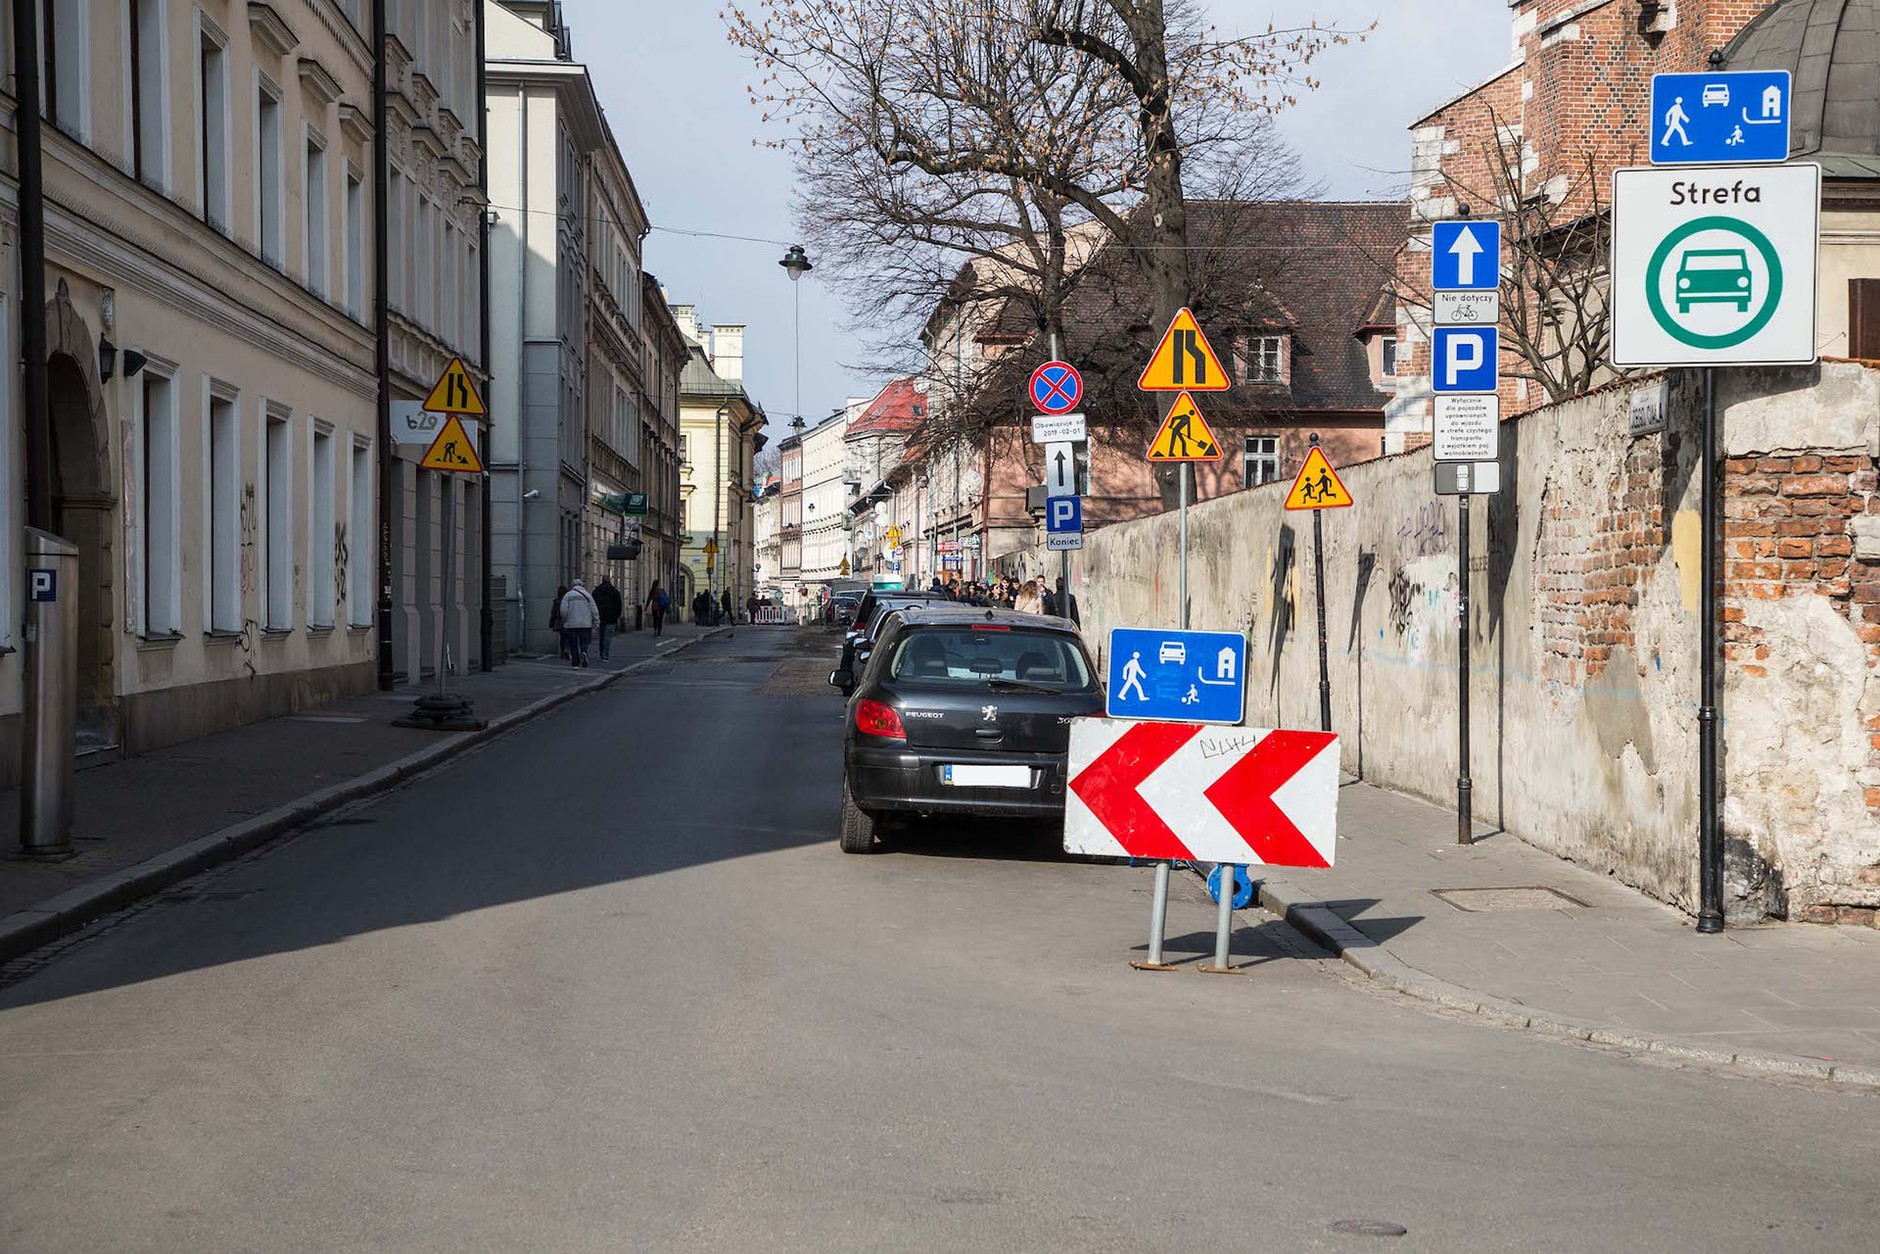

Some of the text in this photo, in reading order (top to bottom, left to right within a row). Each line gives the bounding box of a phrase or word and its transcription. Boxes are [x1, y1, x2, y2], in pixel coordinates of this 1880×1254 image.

[1670, 179, 1761, 205] Strefa
[1441, 294, 1493, 304] Nie dotyczy
[1446, 333, 1484, 385] P
[405, 411, 438, 431] b29
[1053, 500, 1074, 528] P
[1050, 538, 1080, 546] Koniec
[31, 572, 51, 600] P
[905, 711, 944, 719] PEUGEOT
[1057, 716, 1072, 725] 30
